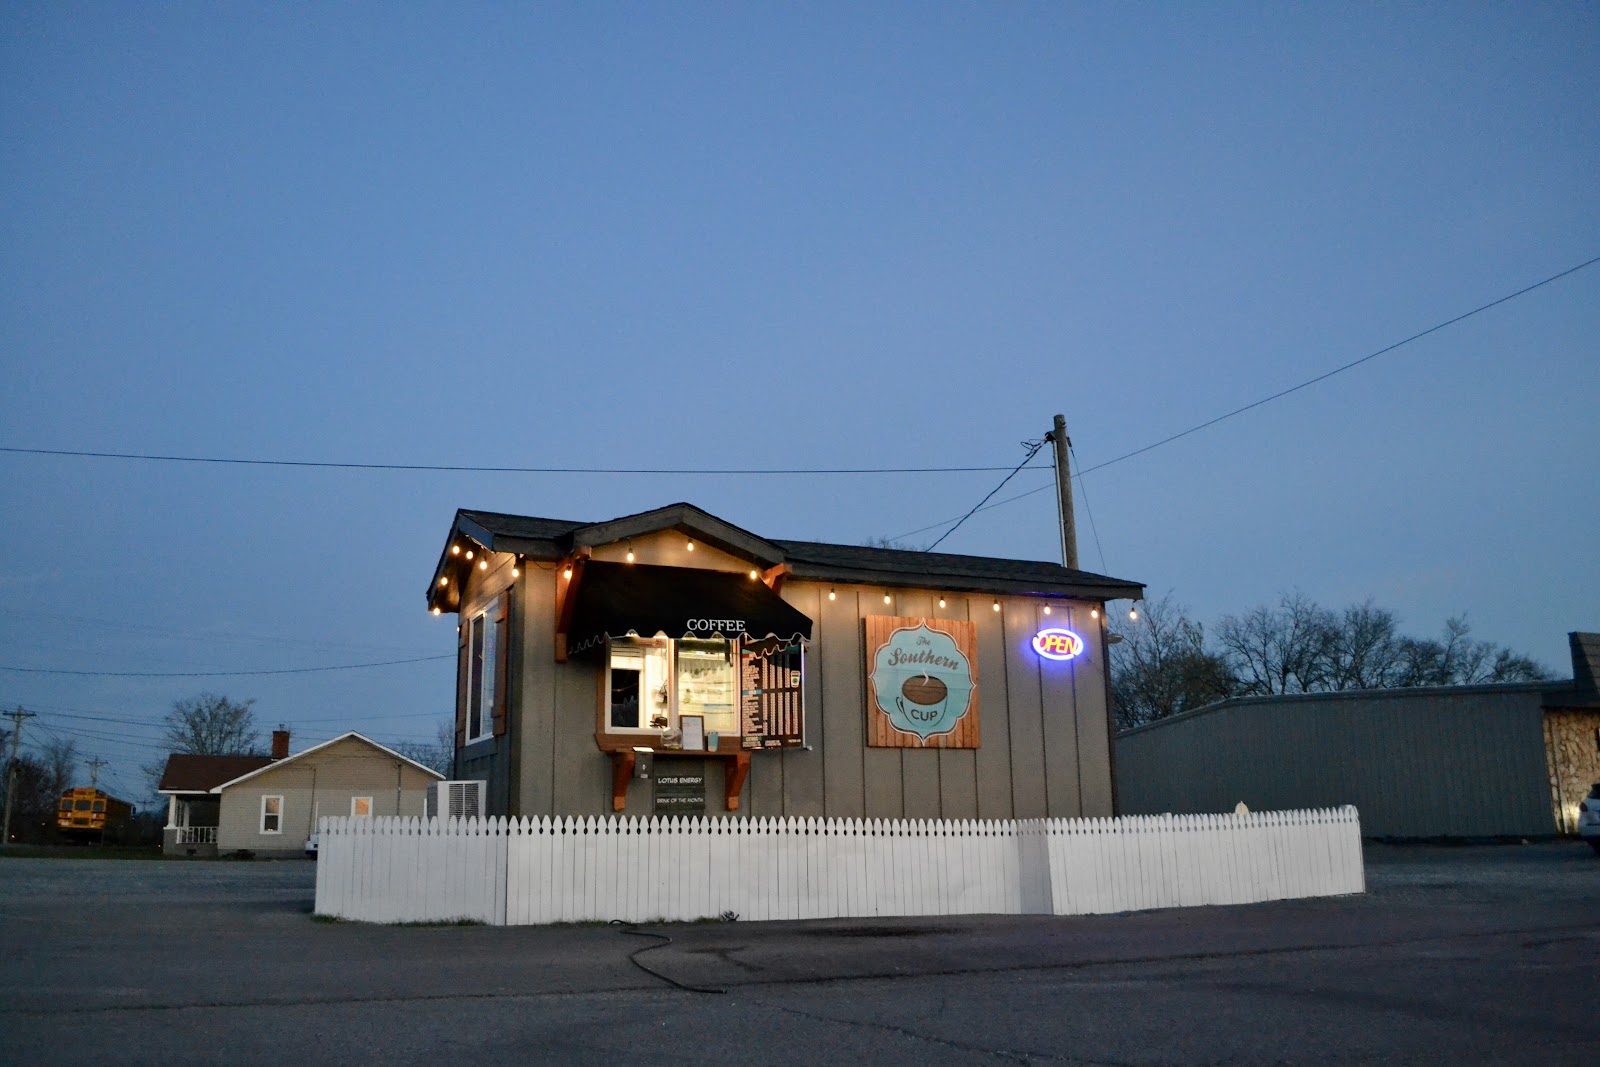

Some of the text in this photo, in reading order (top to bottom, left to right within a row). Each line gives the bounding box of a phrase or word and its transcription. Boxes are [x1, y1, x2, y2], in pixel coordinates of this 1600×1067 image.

[686, 619, 746, 632] COFFEE
[916, 636, 931, 646] The
[1038, 634, 1076, 654] OPEN
[888, 648, 960, 671] Southern
[910, 709, 938, 722] CUP
